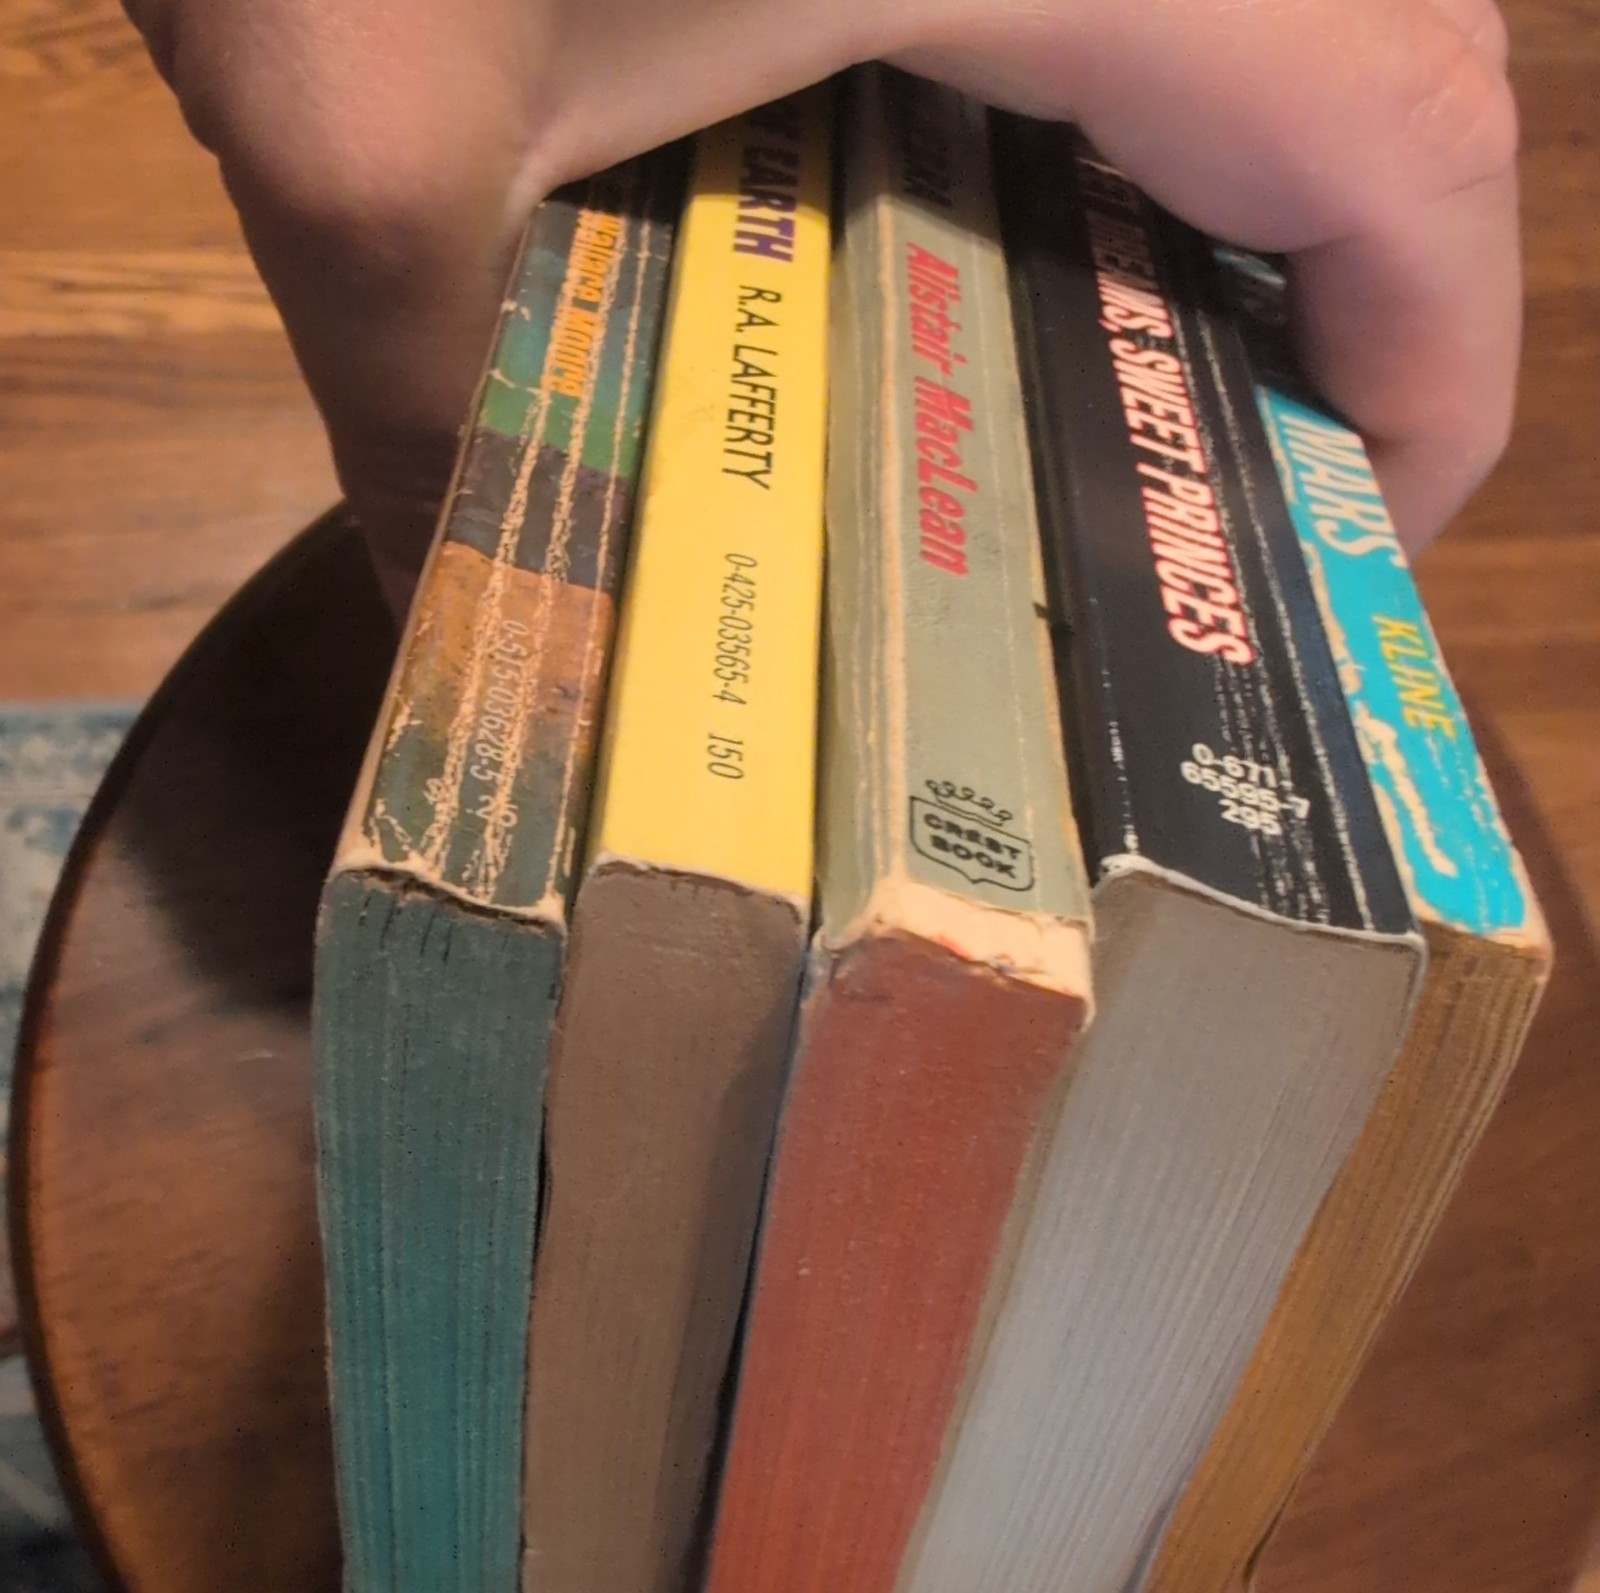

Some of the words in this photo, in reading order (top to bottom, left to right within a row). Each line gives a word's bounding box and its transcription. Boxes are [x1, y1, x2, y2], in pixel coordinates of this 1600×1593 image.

[733, 145, 799, 263] EARTH
[735, 284, 782, 333] R.A.
[906, 242, 967, 376] Alistair
[721, 343, 779, 491] LAFFERTY
[1108, 337, 1208, 475] SWEET
[914, 375, 979, 578] MacLean
[1279, 413, 1409, 569] MARS
[711, 552, 758, 706] 0-425-03565-4
[1135, 460, 1256, 666] PRINCES
[1371, 613, 1457, 740] KLINE
[707, 732, 745, 781] 150
[923, 812, 1023, 860] CREST
[930, 834, 1017, 880] BOOK
